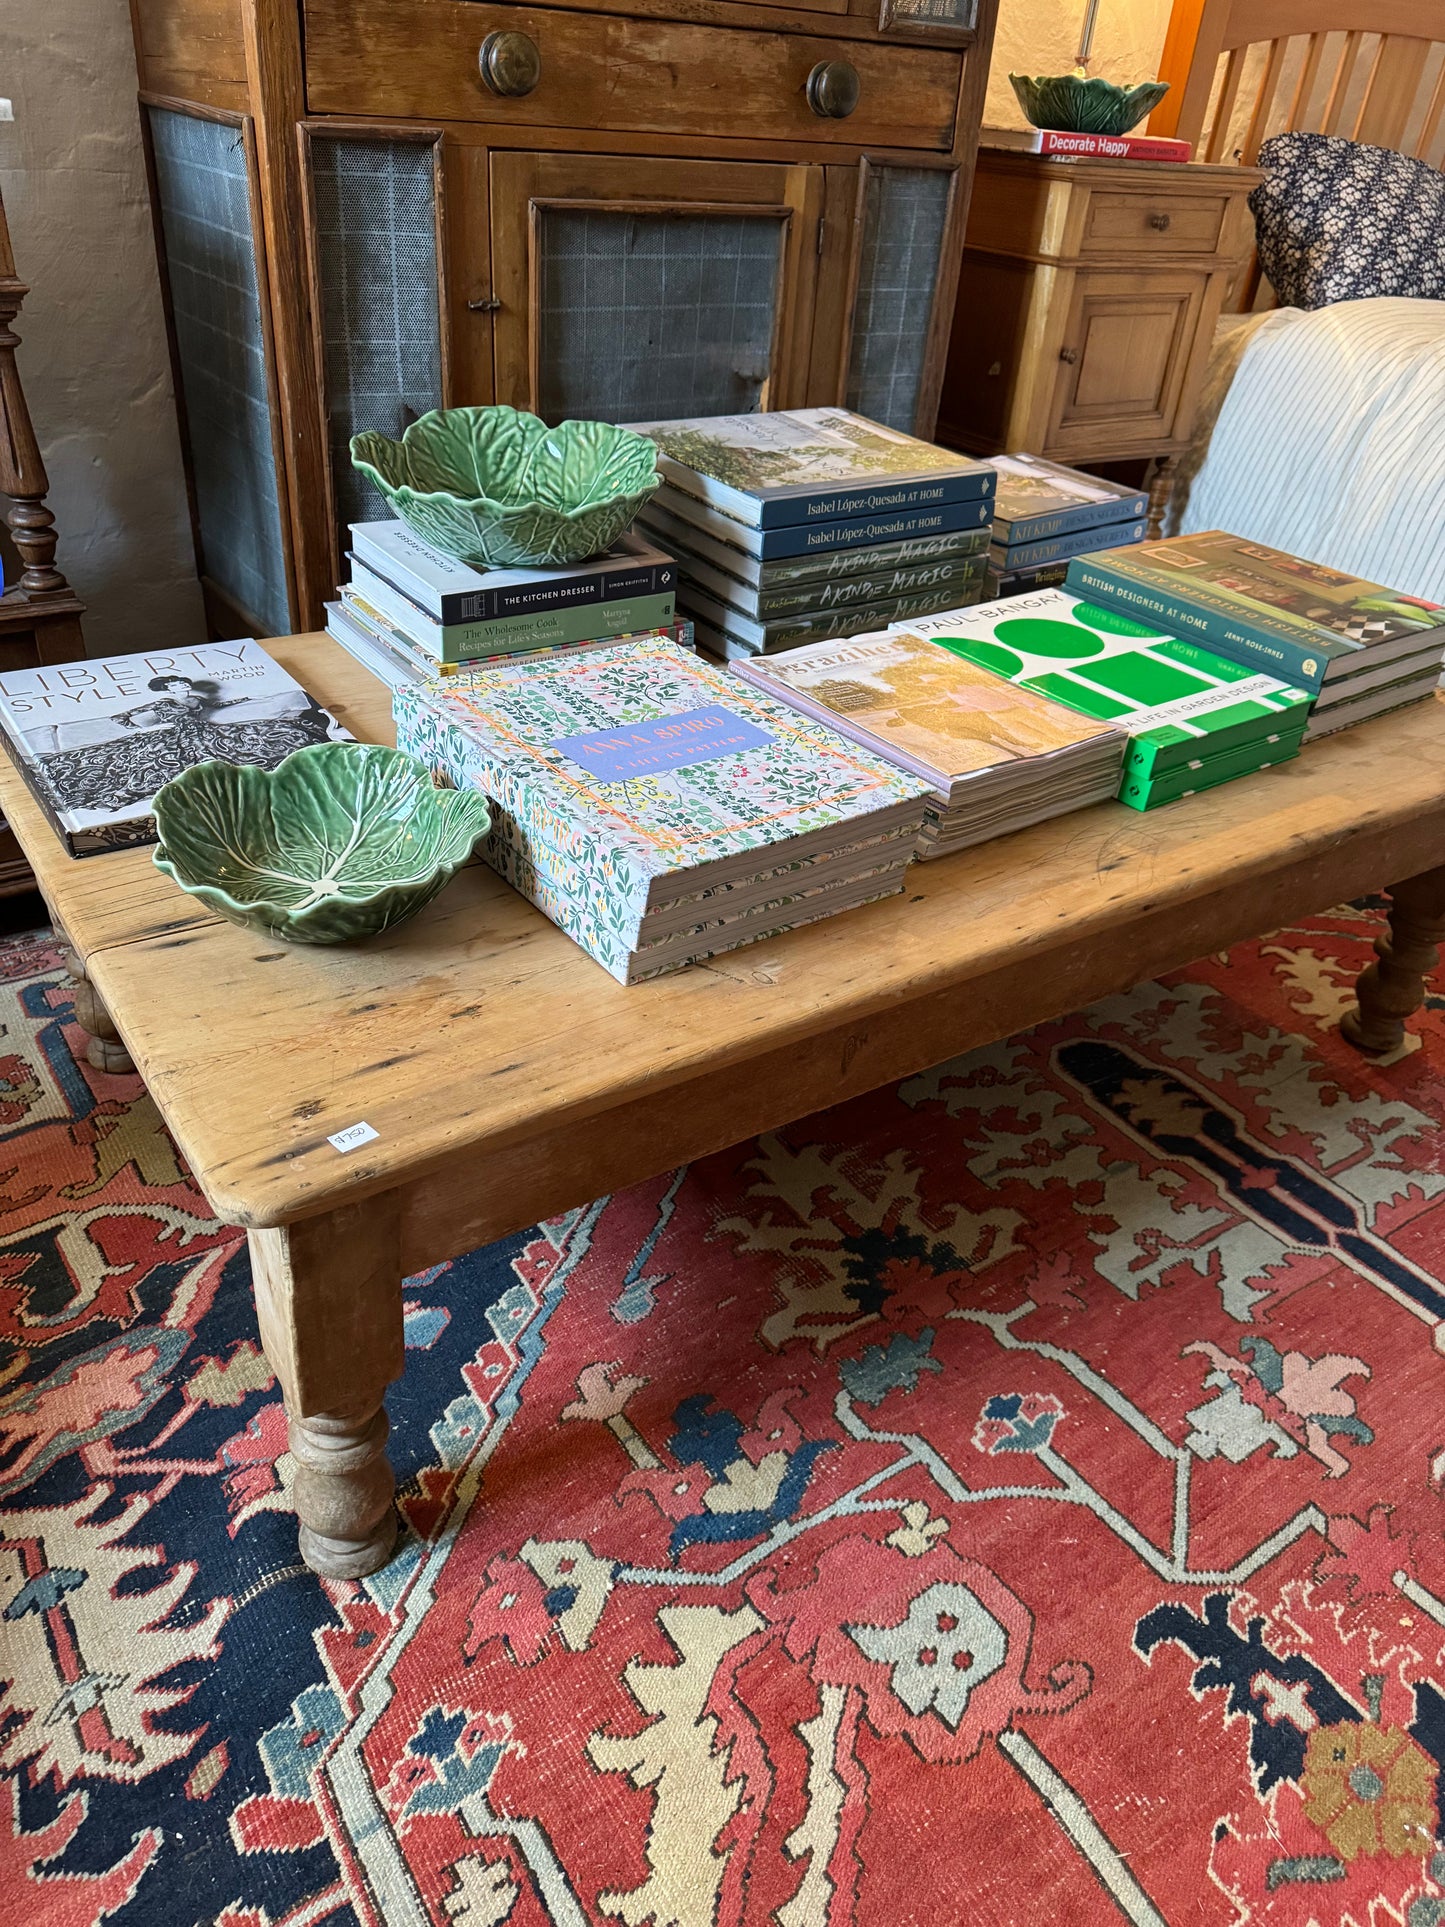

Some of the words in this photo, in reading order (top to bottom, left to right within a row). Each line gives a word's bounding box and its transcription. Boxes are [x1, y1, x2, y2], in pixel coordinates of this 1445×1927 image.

[1049, 134, 1095, 152] Decorate
[1097, 138, 1131, 157] Happy
[807, 499, 836, 516] Isabel
[837, 491, 906, 512] López-Quesada
[907, 491, 918, 502] AT
[919, 487, 945, 500] HOME
[807, 528, 835, 546] Isabel
[836, 520, 905, 541] López-Quesada
[905, 520, 917, 531] AT
[918, 516, 943, 529] HOME
[827, 554, 839, 575] A
[838, 552, 879, 576] KIND
[894, 535, 960, 564] MAGIC
[1102, 557, 1148, 577] HOME
[820, 584, 832, 606] A
[831, 581, 873, 607] KIND
[887, 565, 953, 594] MAGIC
[1148, 575, 1169, 584] AT
[504, 596, 521, 606] THE
[522, 590, 559, 603] KITCHEN
[560, 585, 595, 597] DRESSER
[1081, 574, 1115, 593] BRITISH
[1116, 587, 1164, 613] DESIGNERS
[1166, 607, 1178, 618] AT
[1179, 612, 1209, 631] HOME
[1171, 583, 1259, 619] DESIGNERS
[827, 615, 839, 635] A
[891, 591, 952, 620] MAGIC
[914, 614, 979, 633] PAUL
[979, 593, 1064, 619] BANGAY
[459, 640, 492, 653] Recipes
[493, 636, 506, 646] for
[531, 630, 565, 641] Seasons
[463, 629, 482, 640] The
[485, 622, 534, 637] Wholesome
[536, 617, 558, 628] Cook
[1261, 618, 1332, 647] BRITISH
[785, 644, 903, 676] graziher
[1223, 631, 1245, 644] JENNY
[1245, 639, 1285, 660] ROSE-INNES
[0, 645, 246, 697] LIBERTY
[208, 664, 265, 678] MARTIN
[217, 671, 265, 682] WOOD
[11, 682, 142, 713] STYLE
[1126, 721, 1135, 729] A
[1136, 712, 1165, 725] LIFE
[1165, 707, 1182, 717] IN
[1181, 693, 1228, 711] GARDEN
[1228, 680, 1273, 697] DESIGN
[582, 734, 651, 756] ANNA
[653, 715, 725, 740] SPIRO
